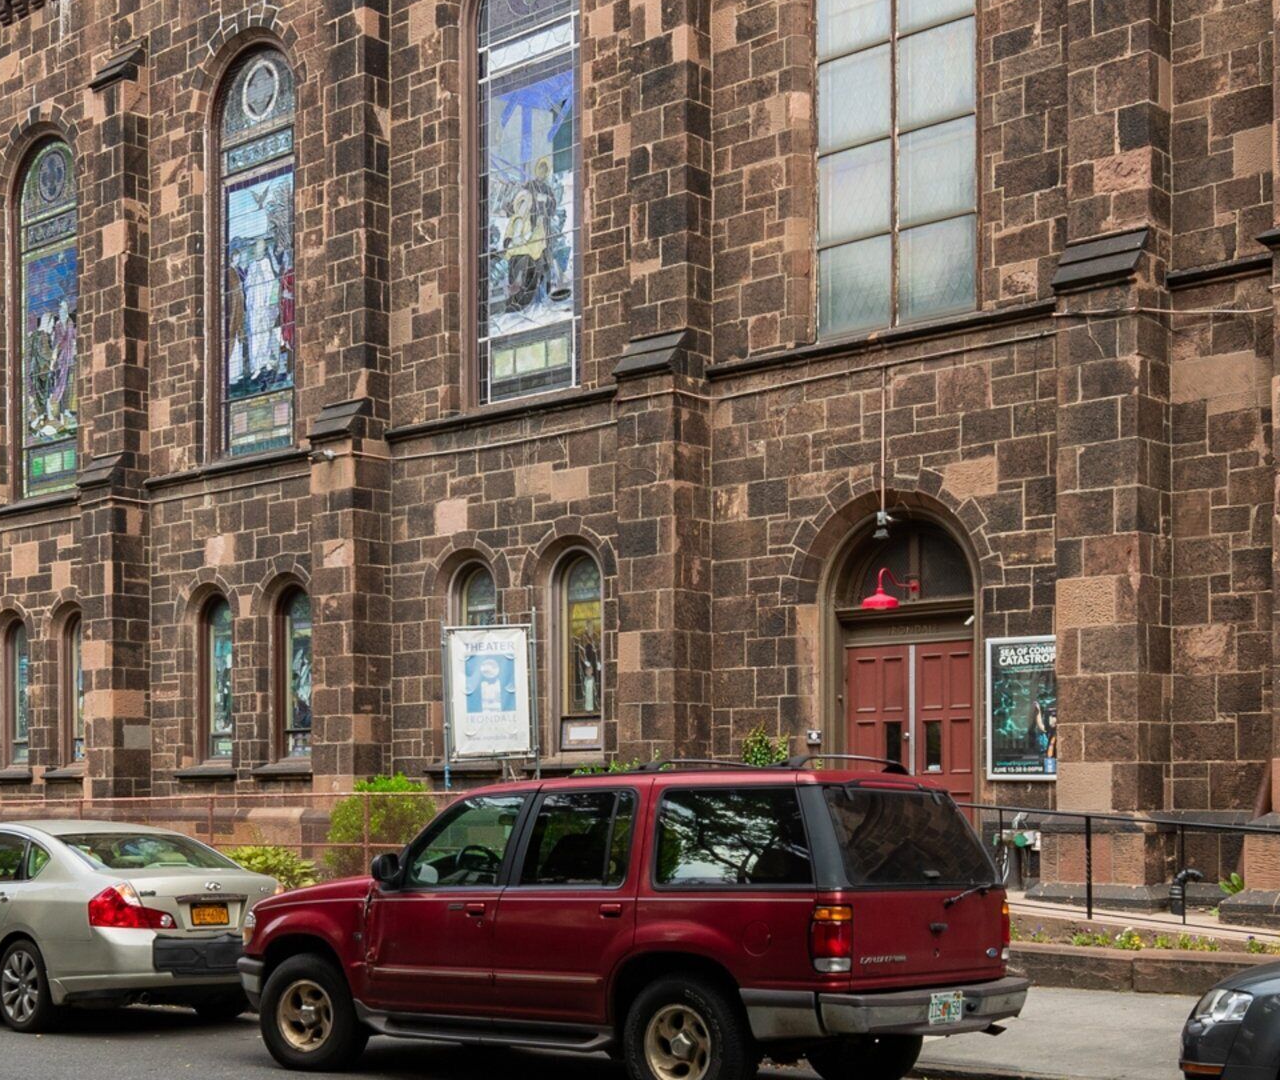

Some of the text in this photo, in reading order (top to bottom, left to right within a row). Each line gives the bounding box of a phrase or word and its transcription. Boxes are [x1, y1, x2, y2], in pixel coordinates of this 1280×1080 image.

[464, 640, 513, 652] THEATER
[1000, 648, 1015, 657] SEA
[1017, 647, 1028, 656] OF
